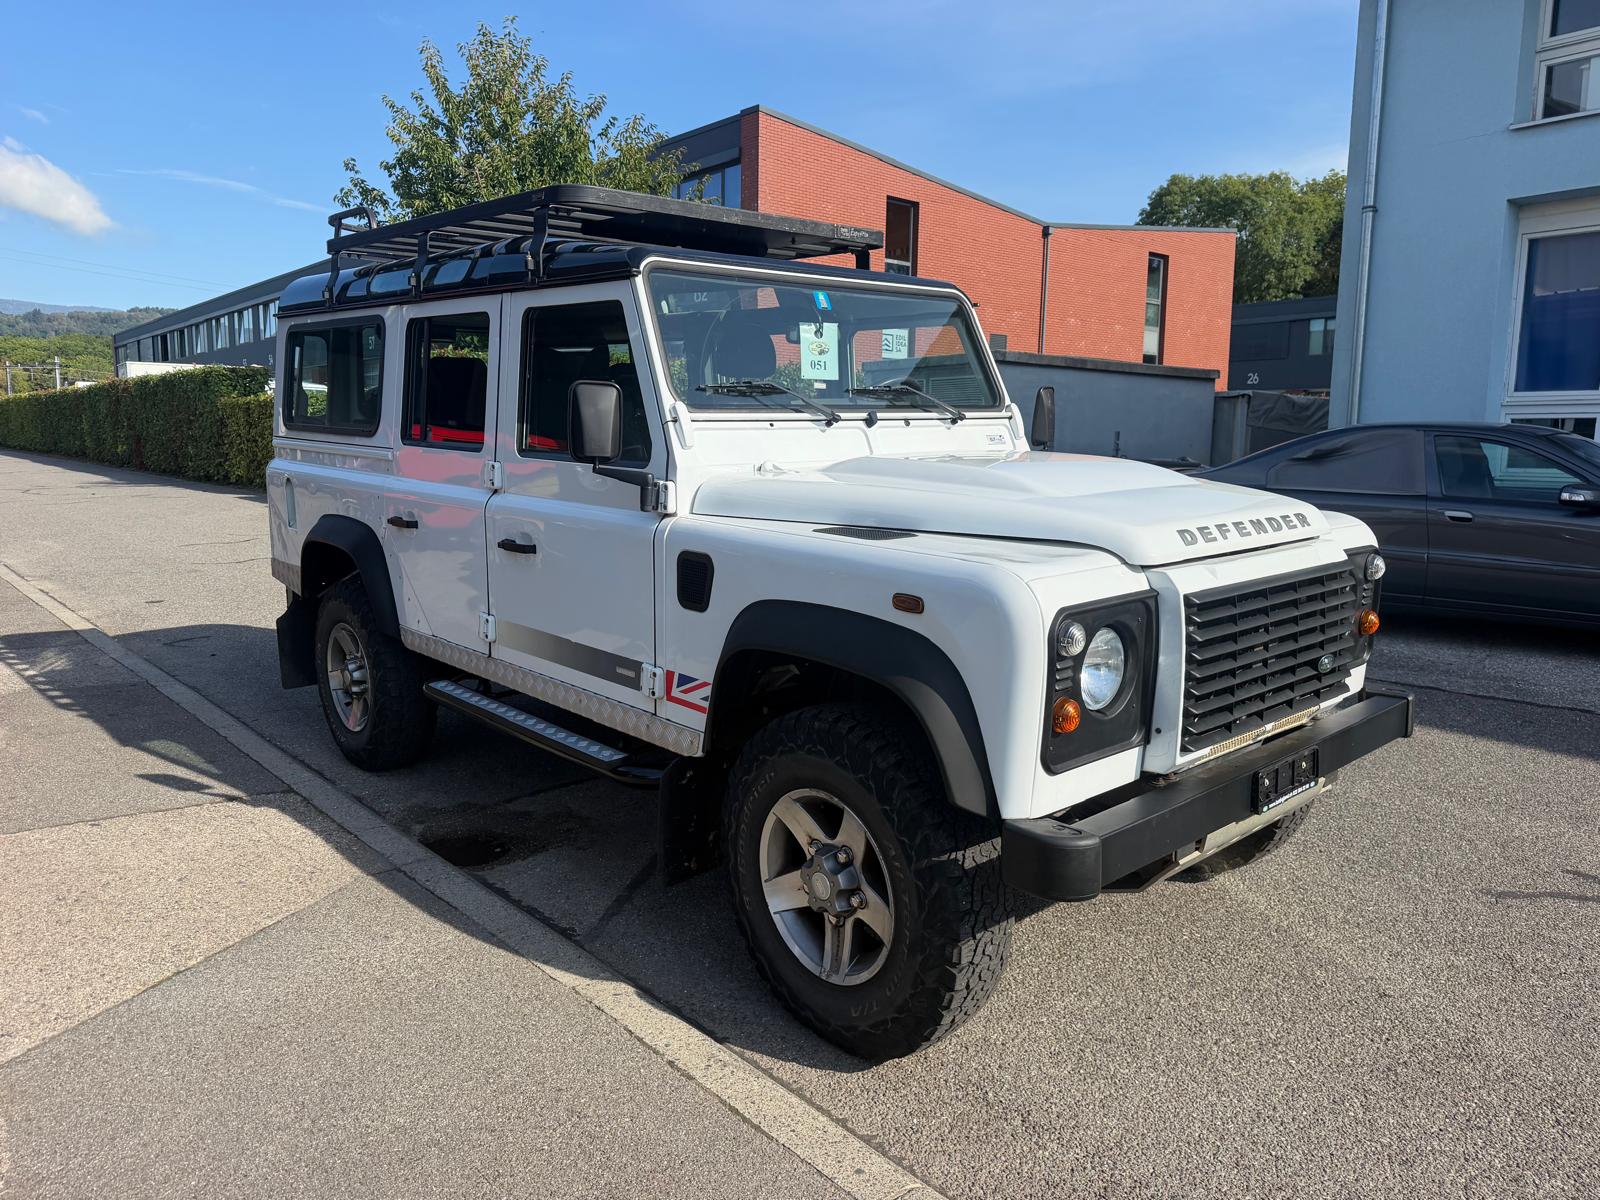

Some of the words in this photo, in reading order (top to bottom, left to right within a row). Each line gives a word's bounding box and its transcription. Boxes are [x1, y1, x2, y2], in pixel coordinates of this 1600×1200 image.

[810, 359, 827, 371] 051
[1246, 372, 1259, 384] 26
[1176, 512, 1312, 547] DEFENDER
